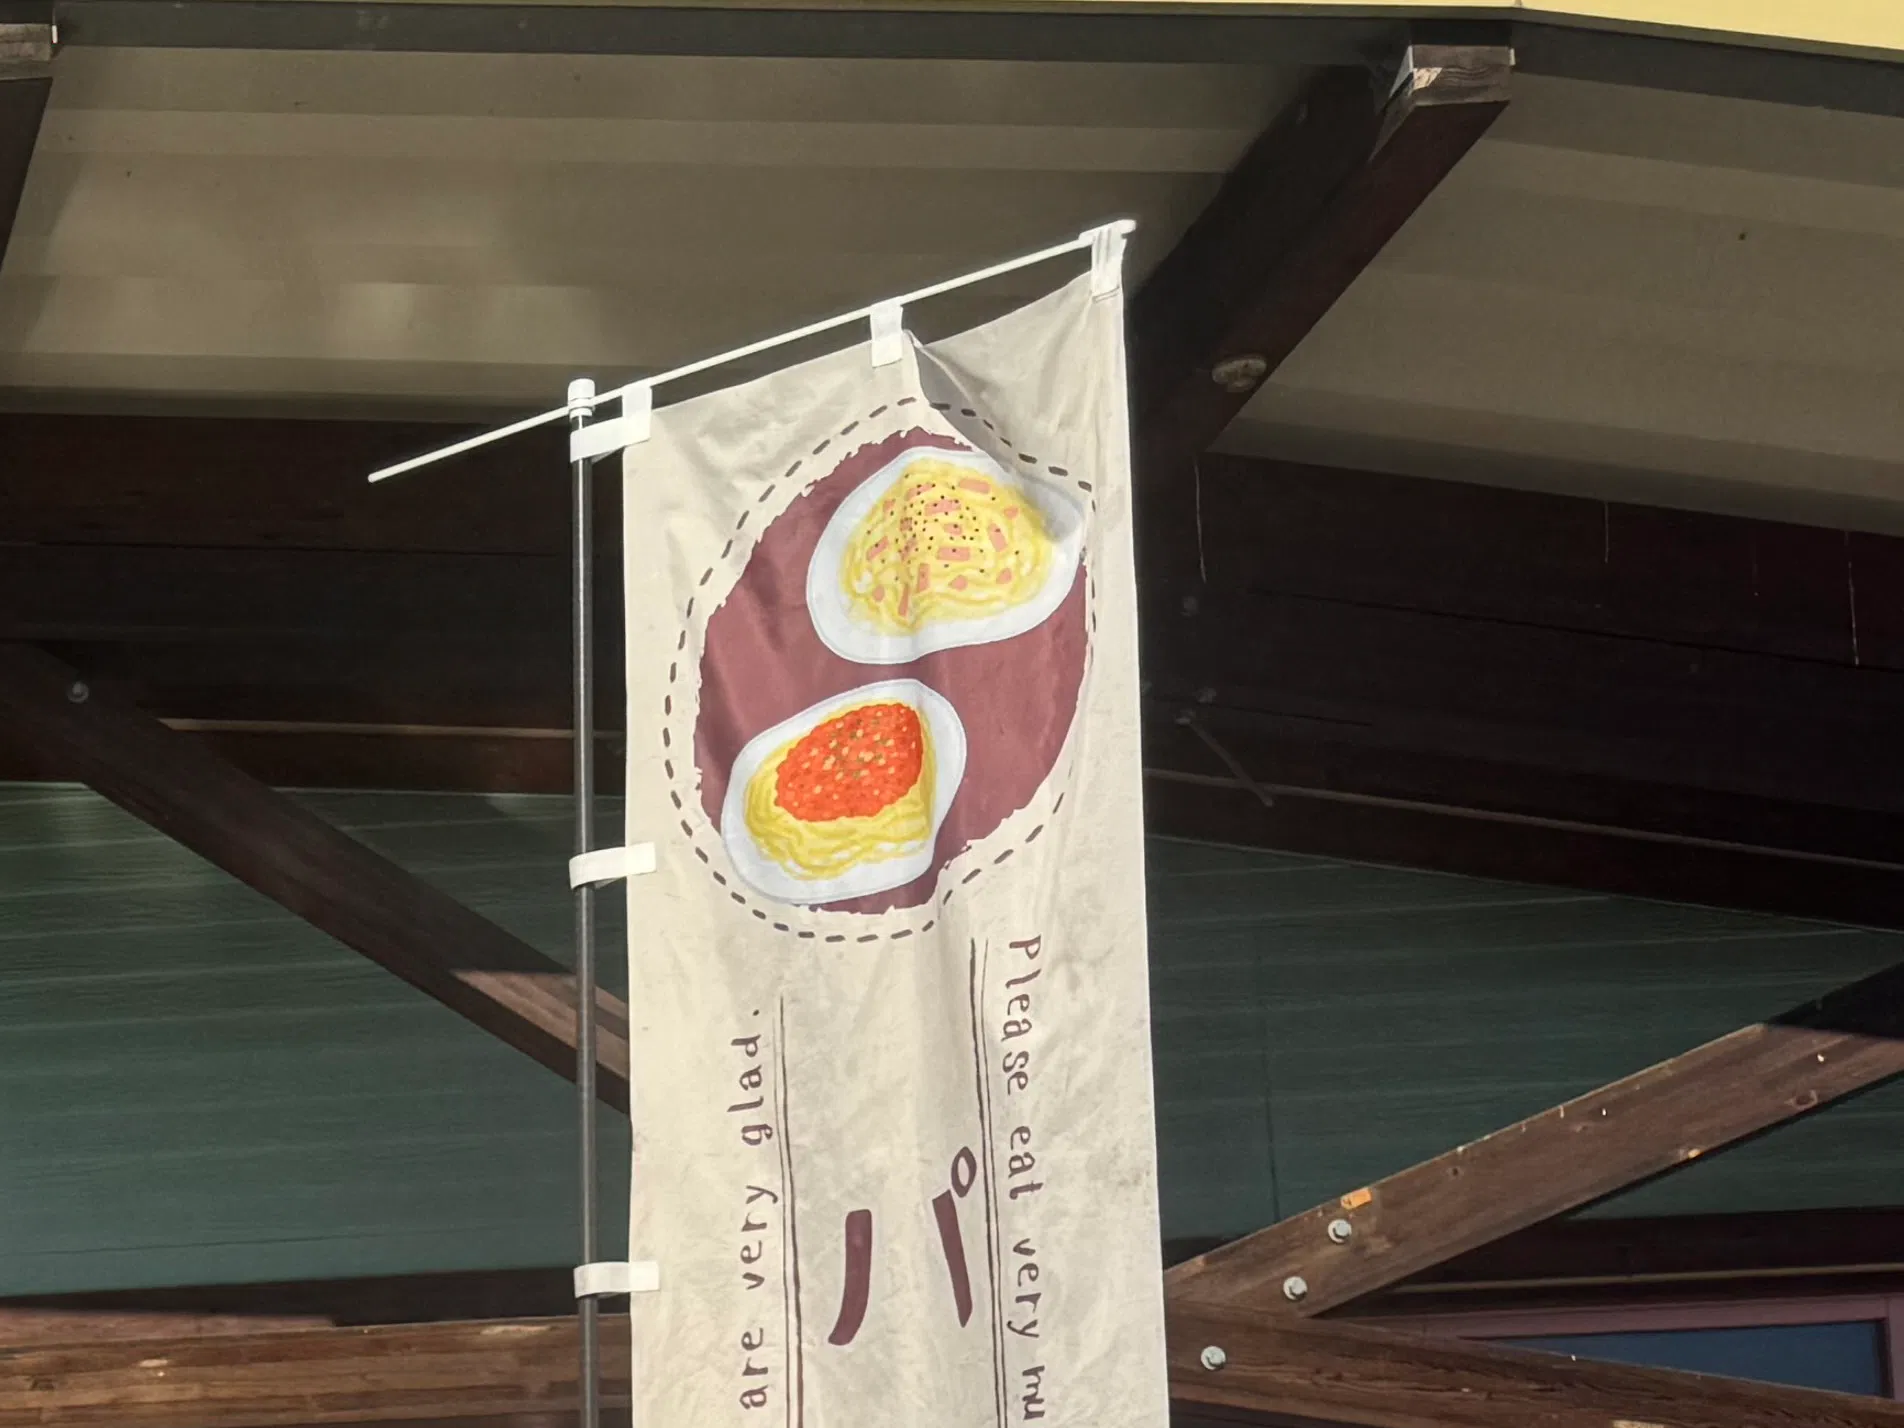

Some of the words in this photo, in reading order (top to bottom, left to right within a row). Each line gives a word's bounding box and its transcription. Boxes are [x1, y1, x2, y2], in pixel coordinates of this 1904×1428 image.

[1002, 936, 1042, 1094] Please
[729, 1010, 771, 1146] glad.
[1008, 1126, 1044, 1200] eat
[741, 1185, 778, 1290] very
[1008, 1238, 1042, 1338] very
[740, 1327, 769, 1410] are
